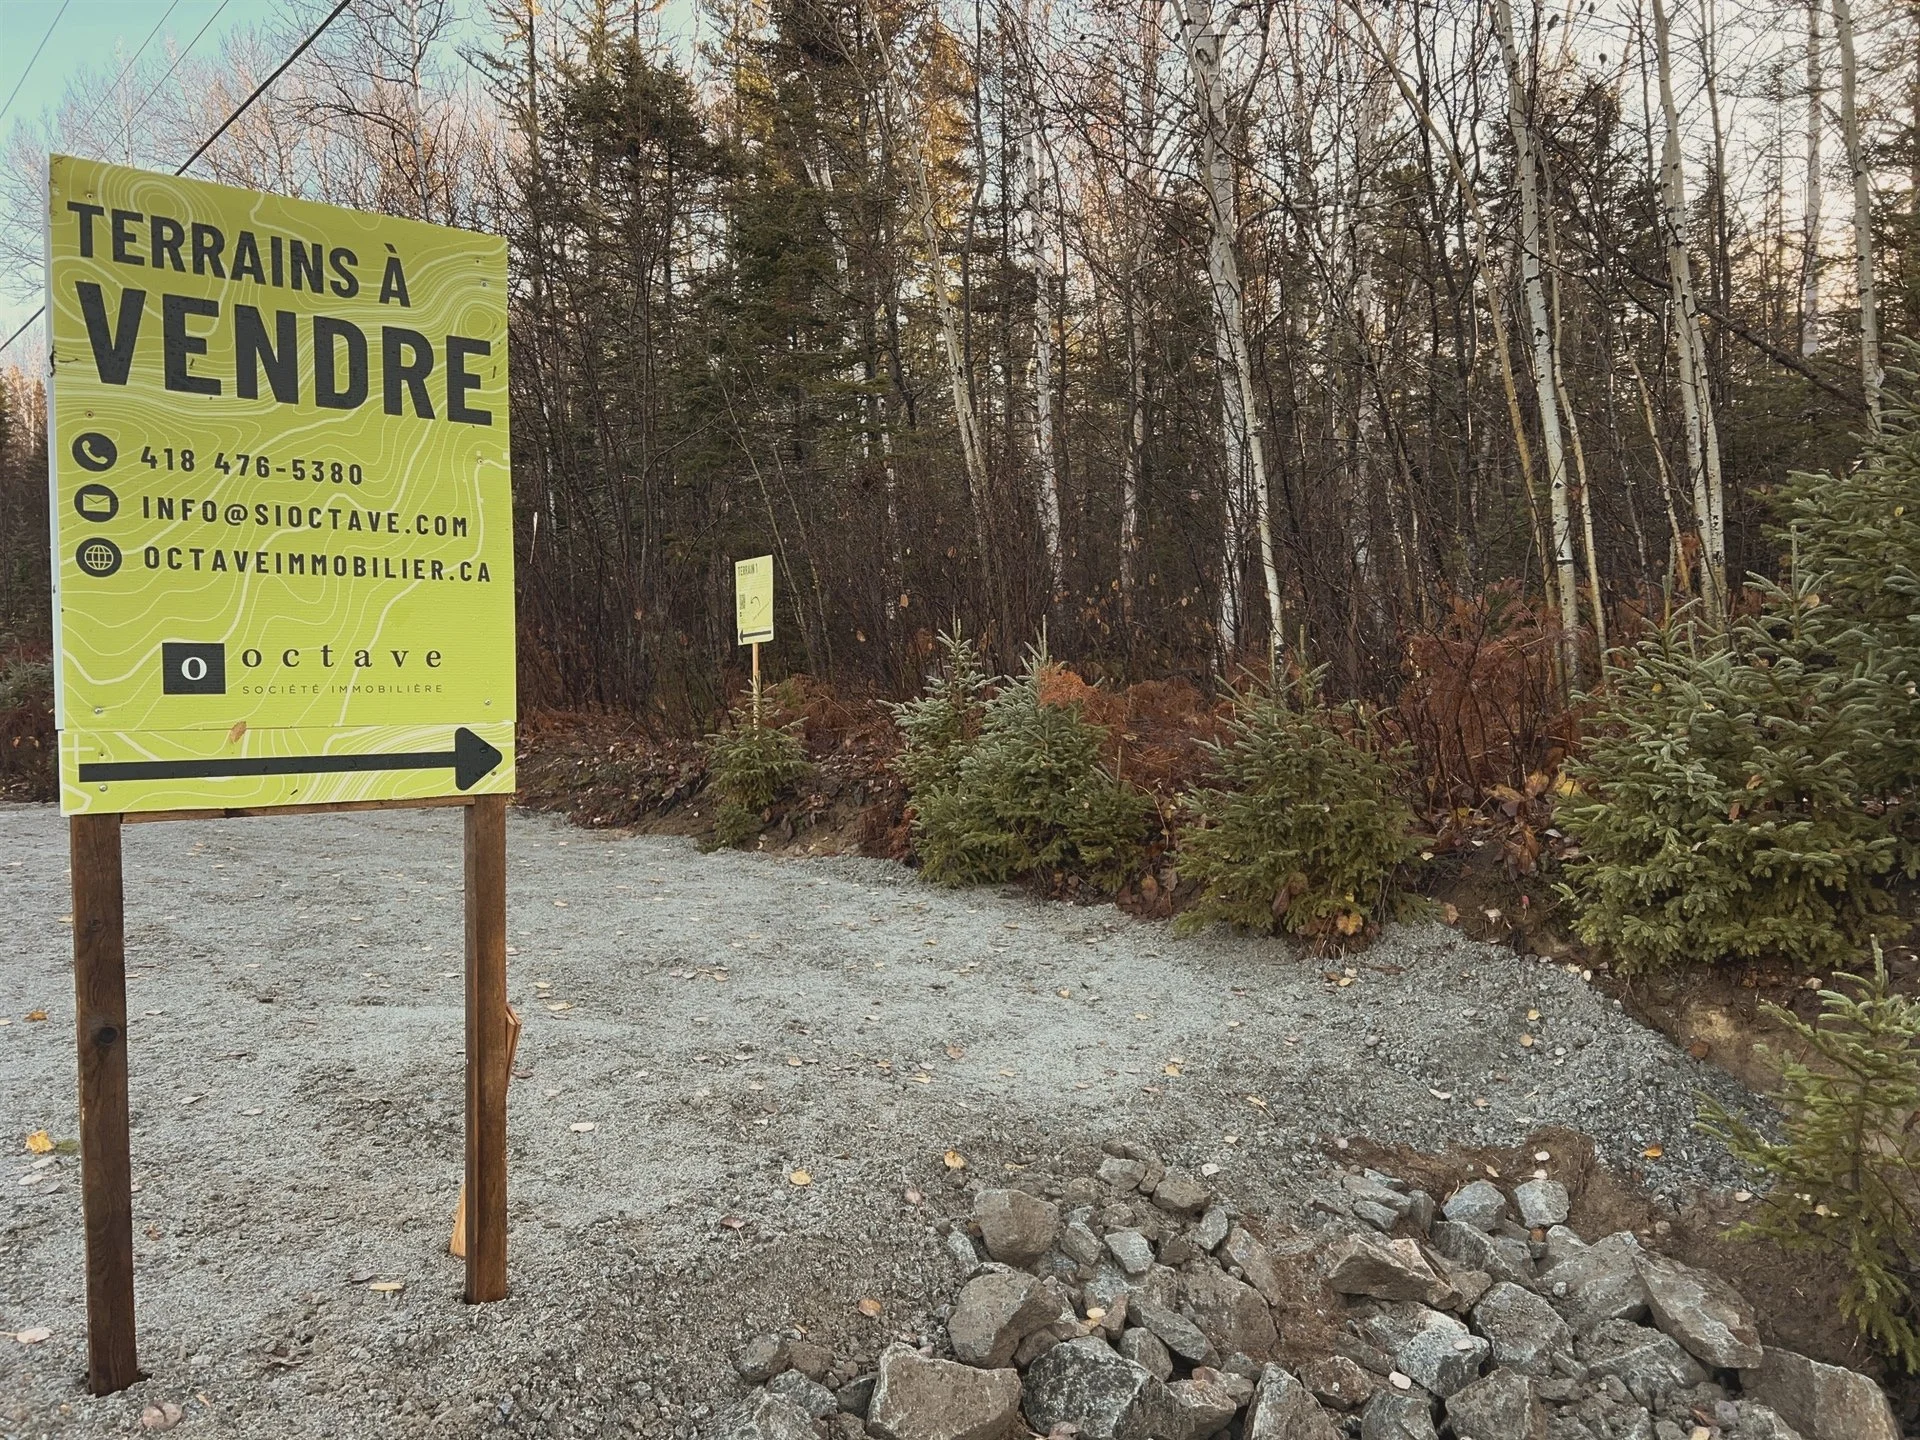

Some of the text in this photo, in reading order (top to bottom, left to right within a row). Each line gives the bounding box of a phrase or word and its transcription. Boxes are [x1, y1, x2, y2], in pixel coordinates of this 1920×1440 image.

[66, 200, 411, 308] TERRAINS À
[74, 280, 492, 426] VENDRE
[140, 445, 364, 486] 418 476-5380
[142, 495, 469, 538] INFO@SIOCTAVE.COM
[143, 545, 491, 583] OCTAVEIMMOBILIER.CA
[241, 644, 443, 669] octave
[242, 683, 443, 695] SOCIÉTÉ IMMOBILIÈRE
